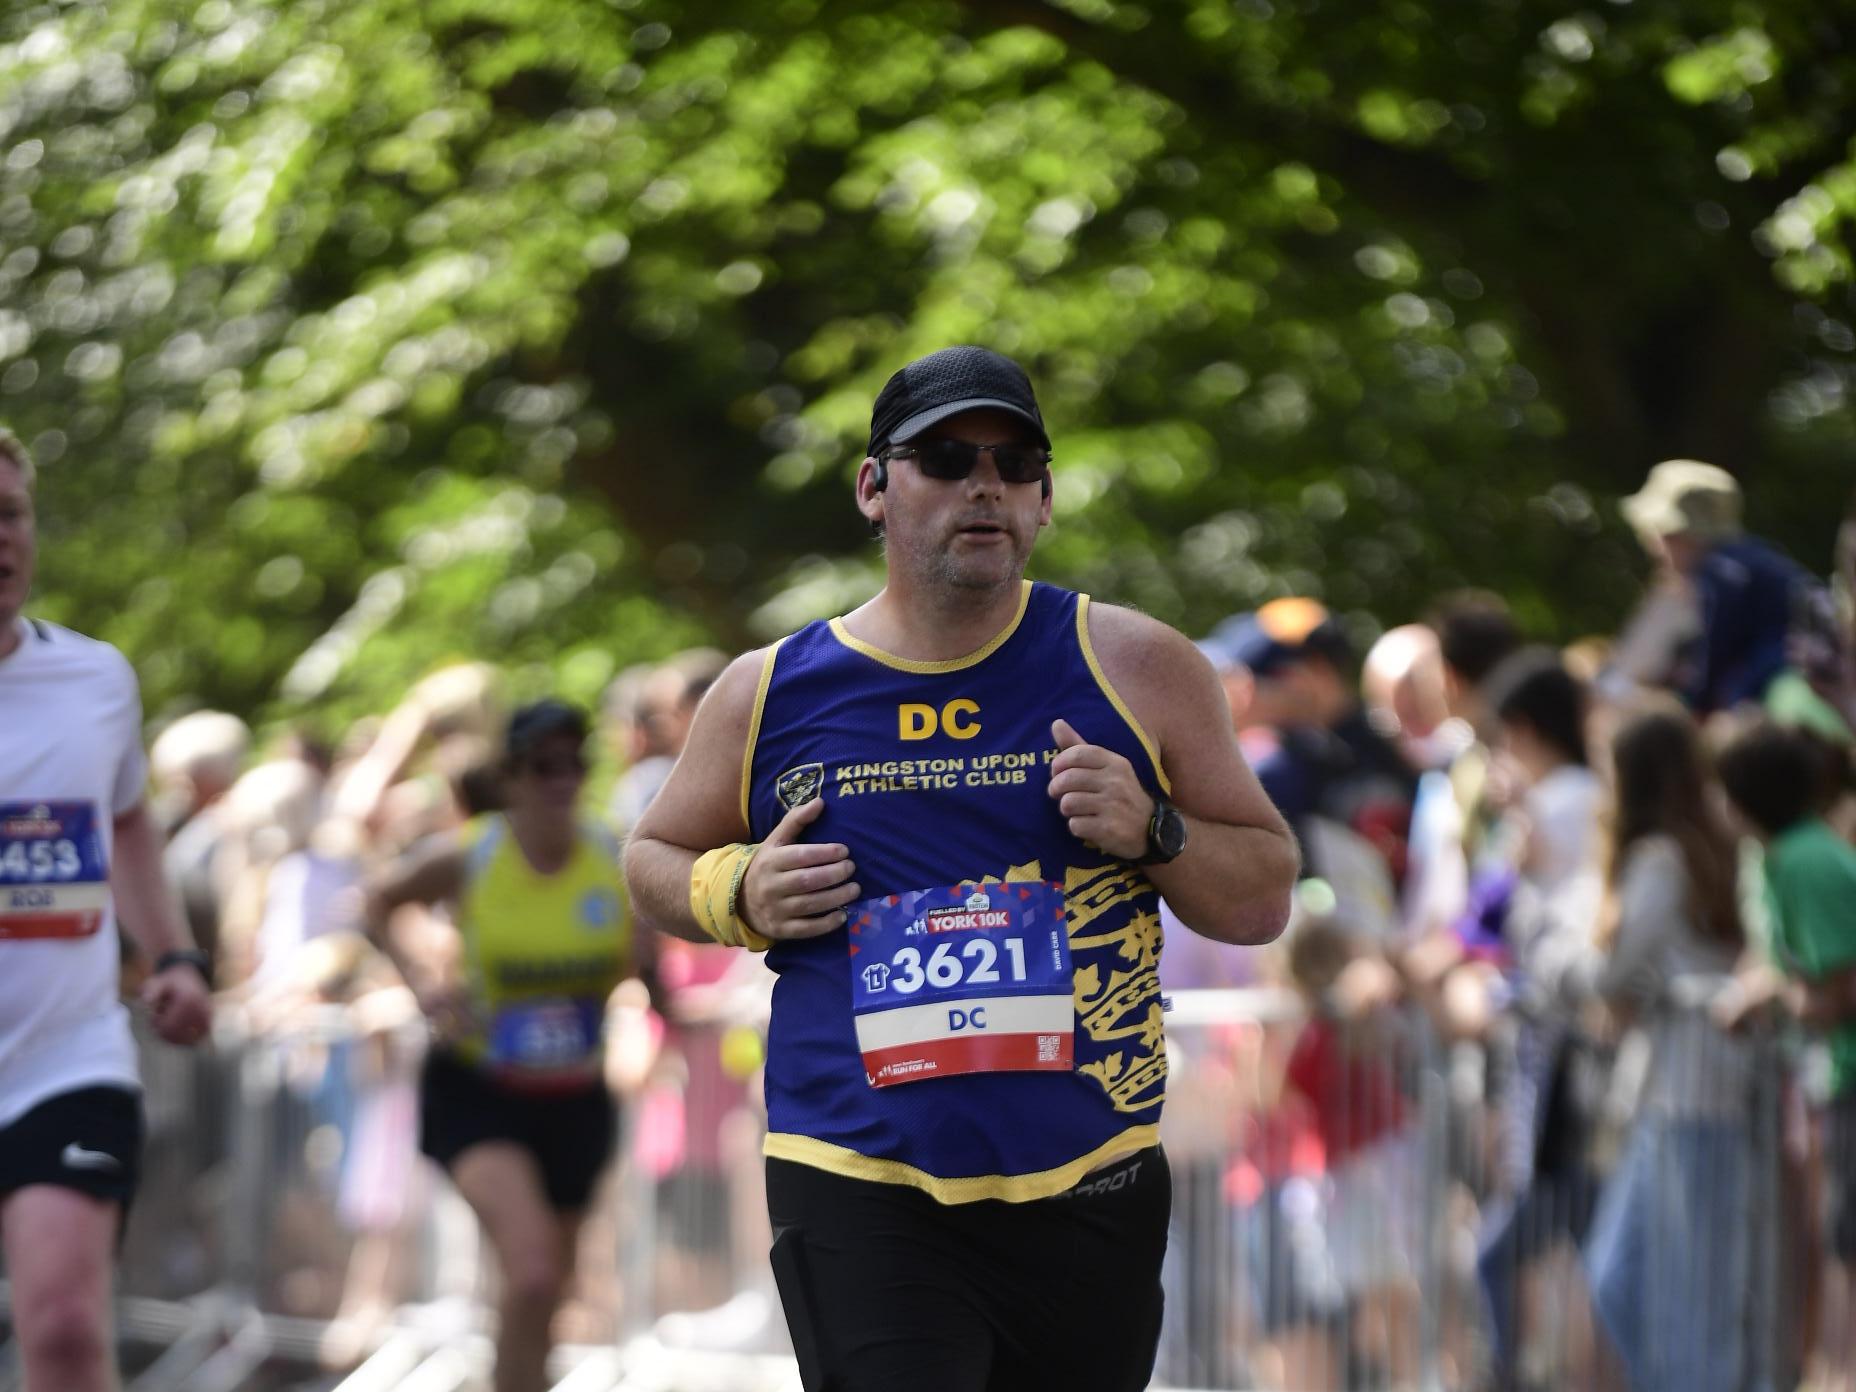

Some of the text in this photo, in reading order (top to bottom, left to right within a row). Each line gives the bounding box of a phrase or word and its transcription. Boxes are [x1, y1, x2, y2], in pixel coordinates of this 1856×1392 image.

[899, 698, 982, 740] DC
[836, 758, 964, 781] KINGSTON
[972, 752, 1036, 770] UPON
[838, 769, 1027, 797] ATHLETIC CLUB
[0, 838, 82, 880] 453
[930, 911, 1009, 931] YORK 10K
[892, 937, 1027, 994] 3621
[1053, 950, 1062, 970] DAVID
[873, 973, 881, 987] L
[948, 1007, 987, 1031] DC
